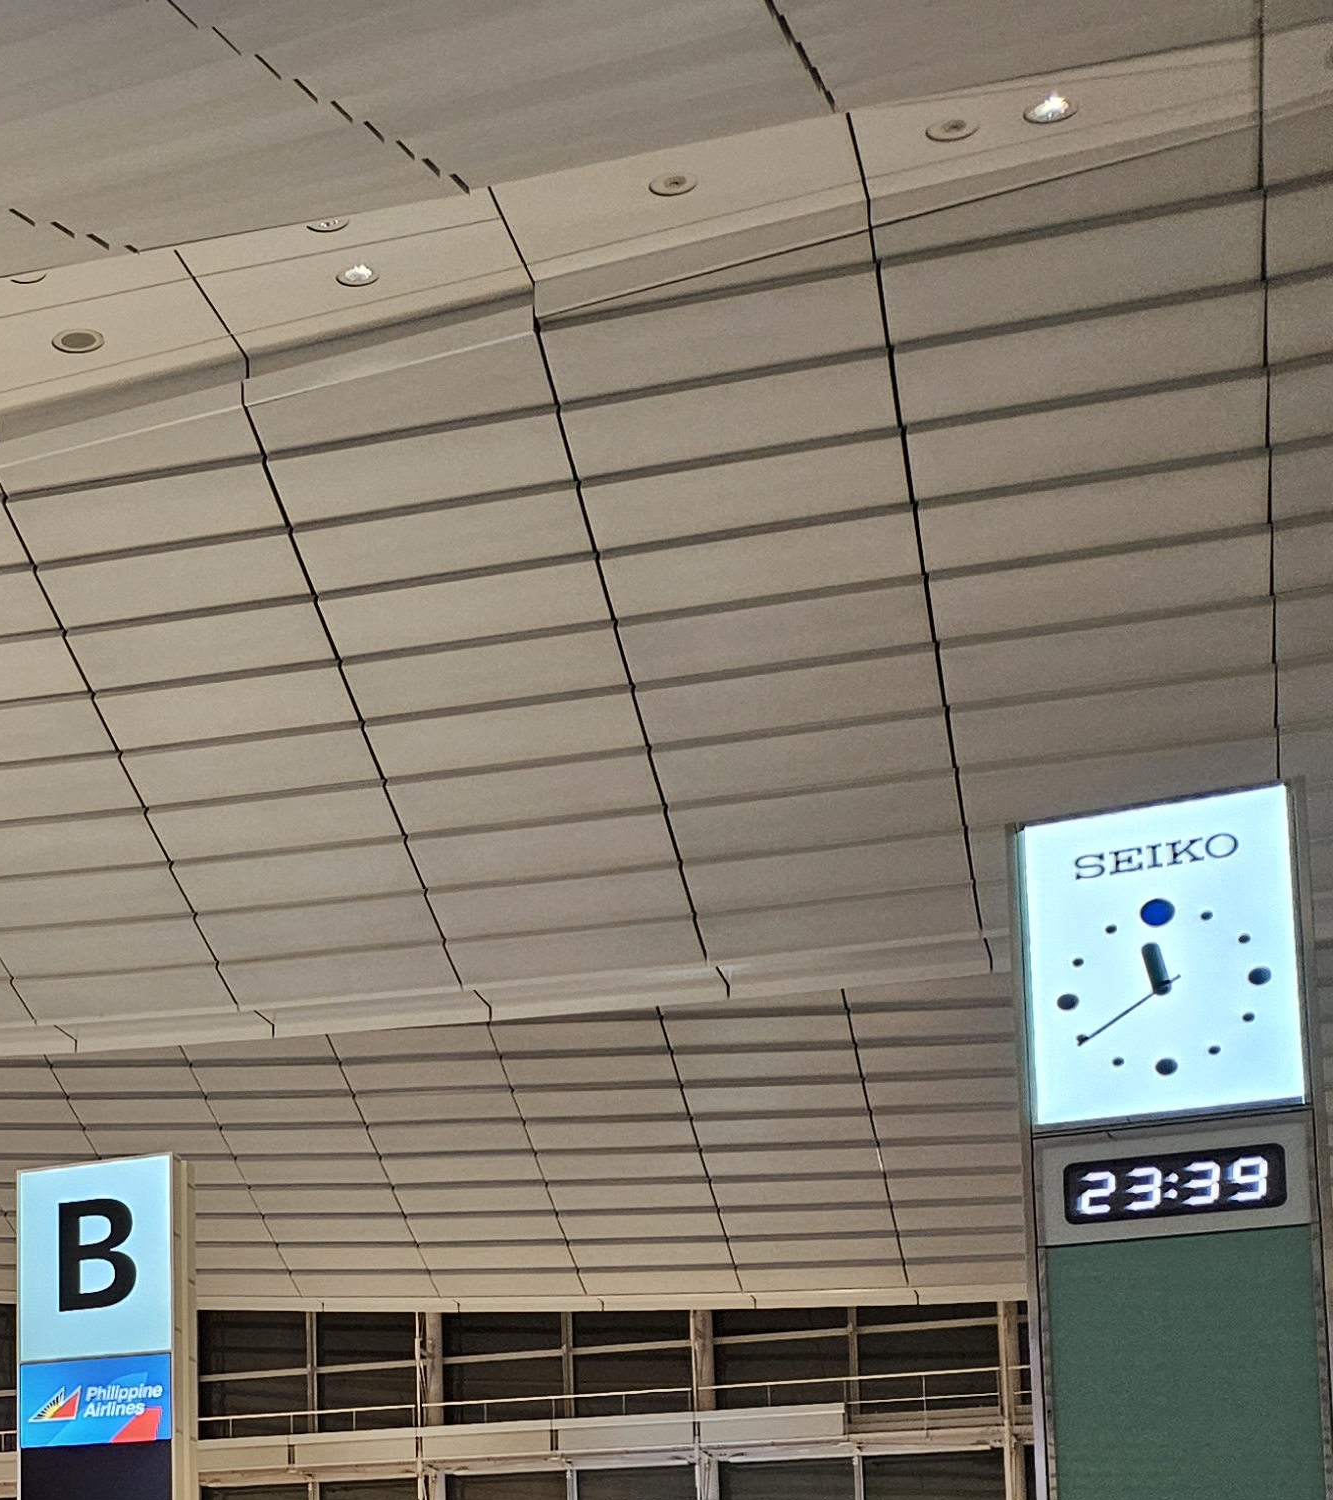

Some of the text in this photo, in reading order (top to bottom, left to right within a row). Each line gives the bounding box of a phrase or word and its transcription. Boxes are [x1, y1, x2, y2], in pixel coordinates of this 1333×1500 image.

[1075, 833, 1239, 881] SEIKO
[1077, 1156, 1267, 1215] 23:39
[58, 1198, 137, 1312] B
[83, 1402, 145, 1418] Airlines
[86, 1383, 163, 1403] Philippine
